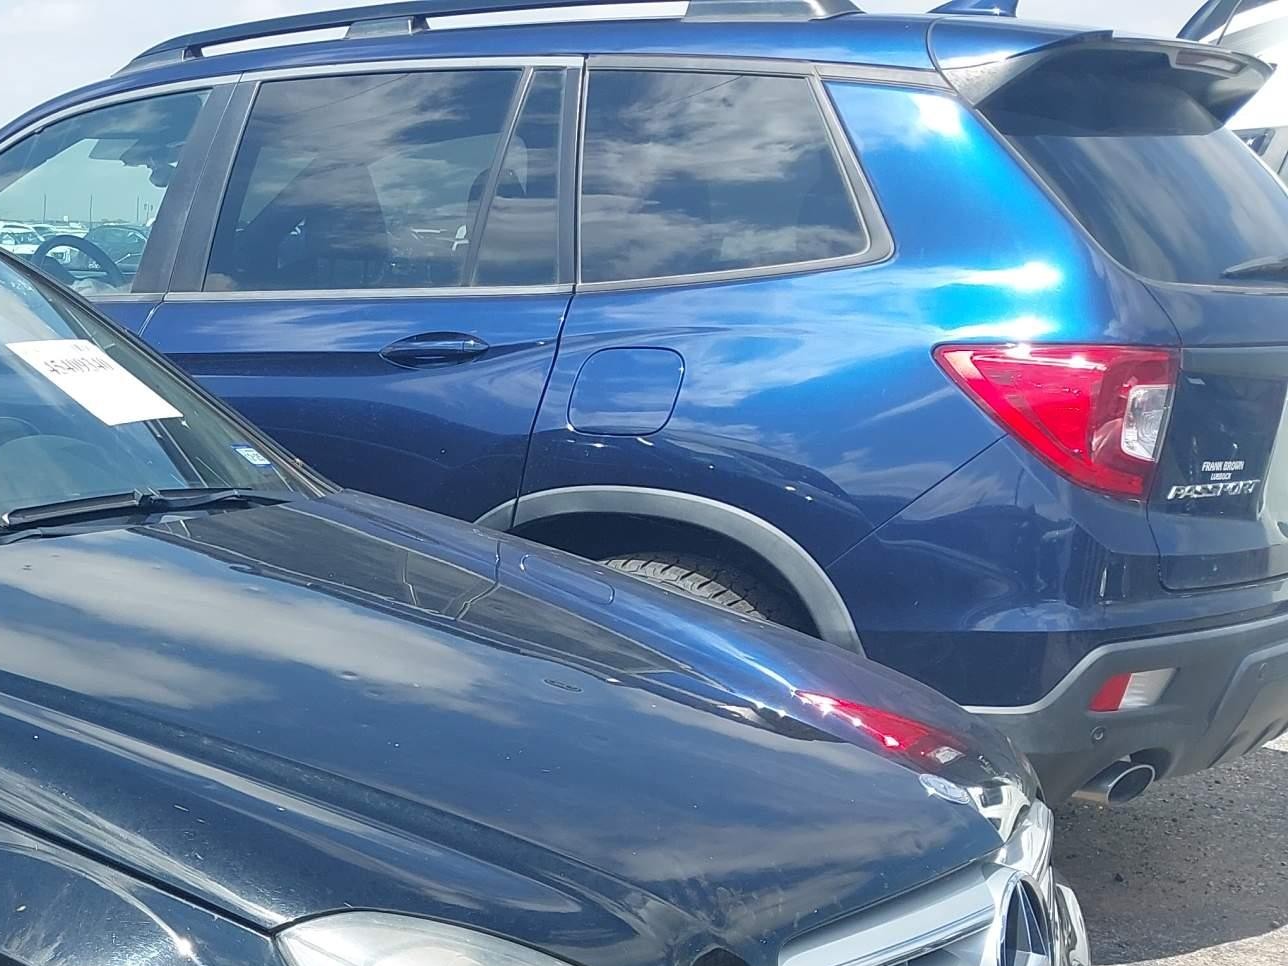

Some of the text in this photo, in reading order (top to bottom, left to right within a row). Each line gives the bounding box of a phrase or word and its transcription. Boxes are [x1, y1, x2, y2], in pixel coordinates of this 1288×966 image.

[43, 356, 115, 376] 45409340
[1201, 460, 1245, 471] FRANK BROWN
[1166, 479, 1261, 500] PASSPORT
